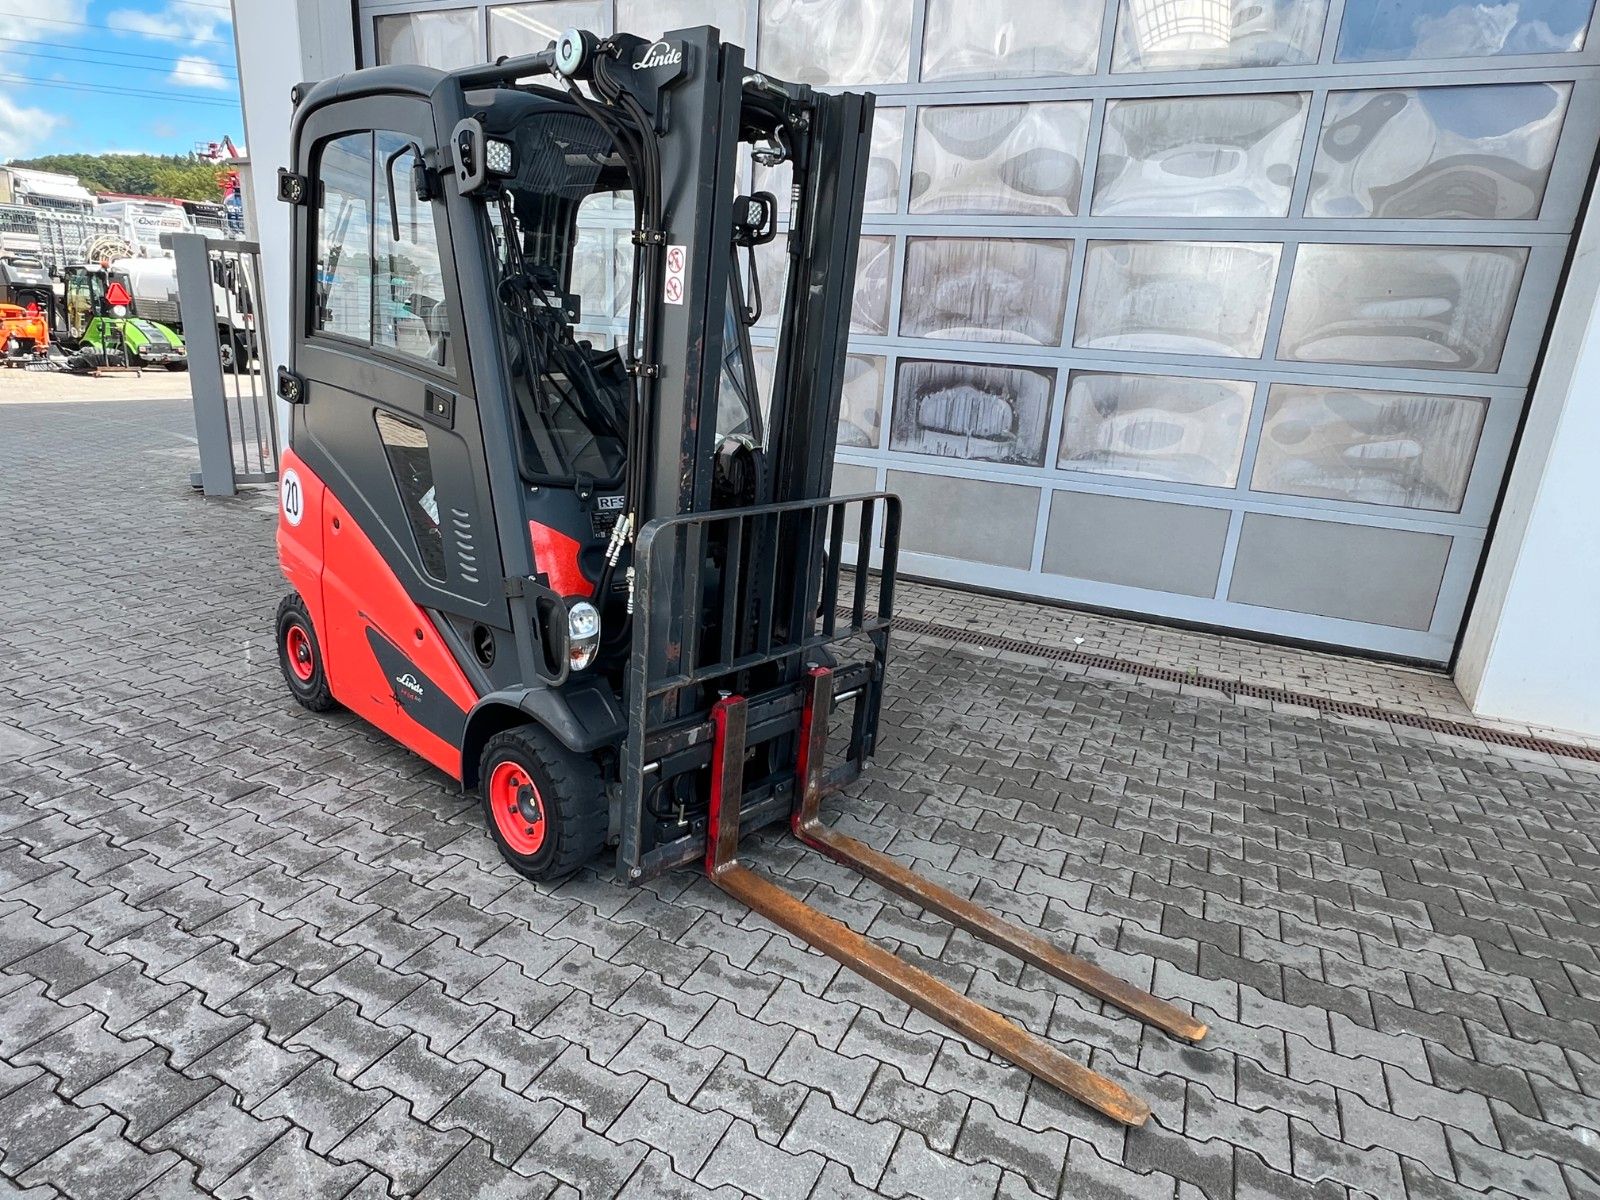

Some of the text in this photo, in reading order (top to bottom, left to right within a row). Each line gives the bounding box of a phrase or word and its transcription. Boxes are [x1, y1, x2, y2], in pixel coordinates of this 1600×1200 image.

[632, 41, 682, 70] Linde
[285, 478, 299, 516] 20
[396, 673, 424, 696] Linde
